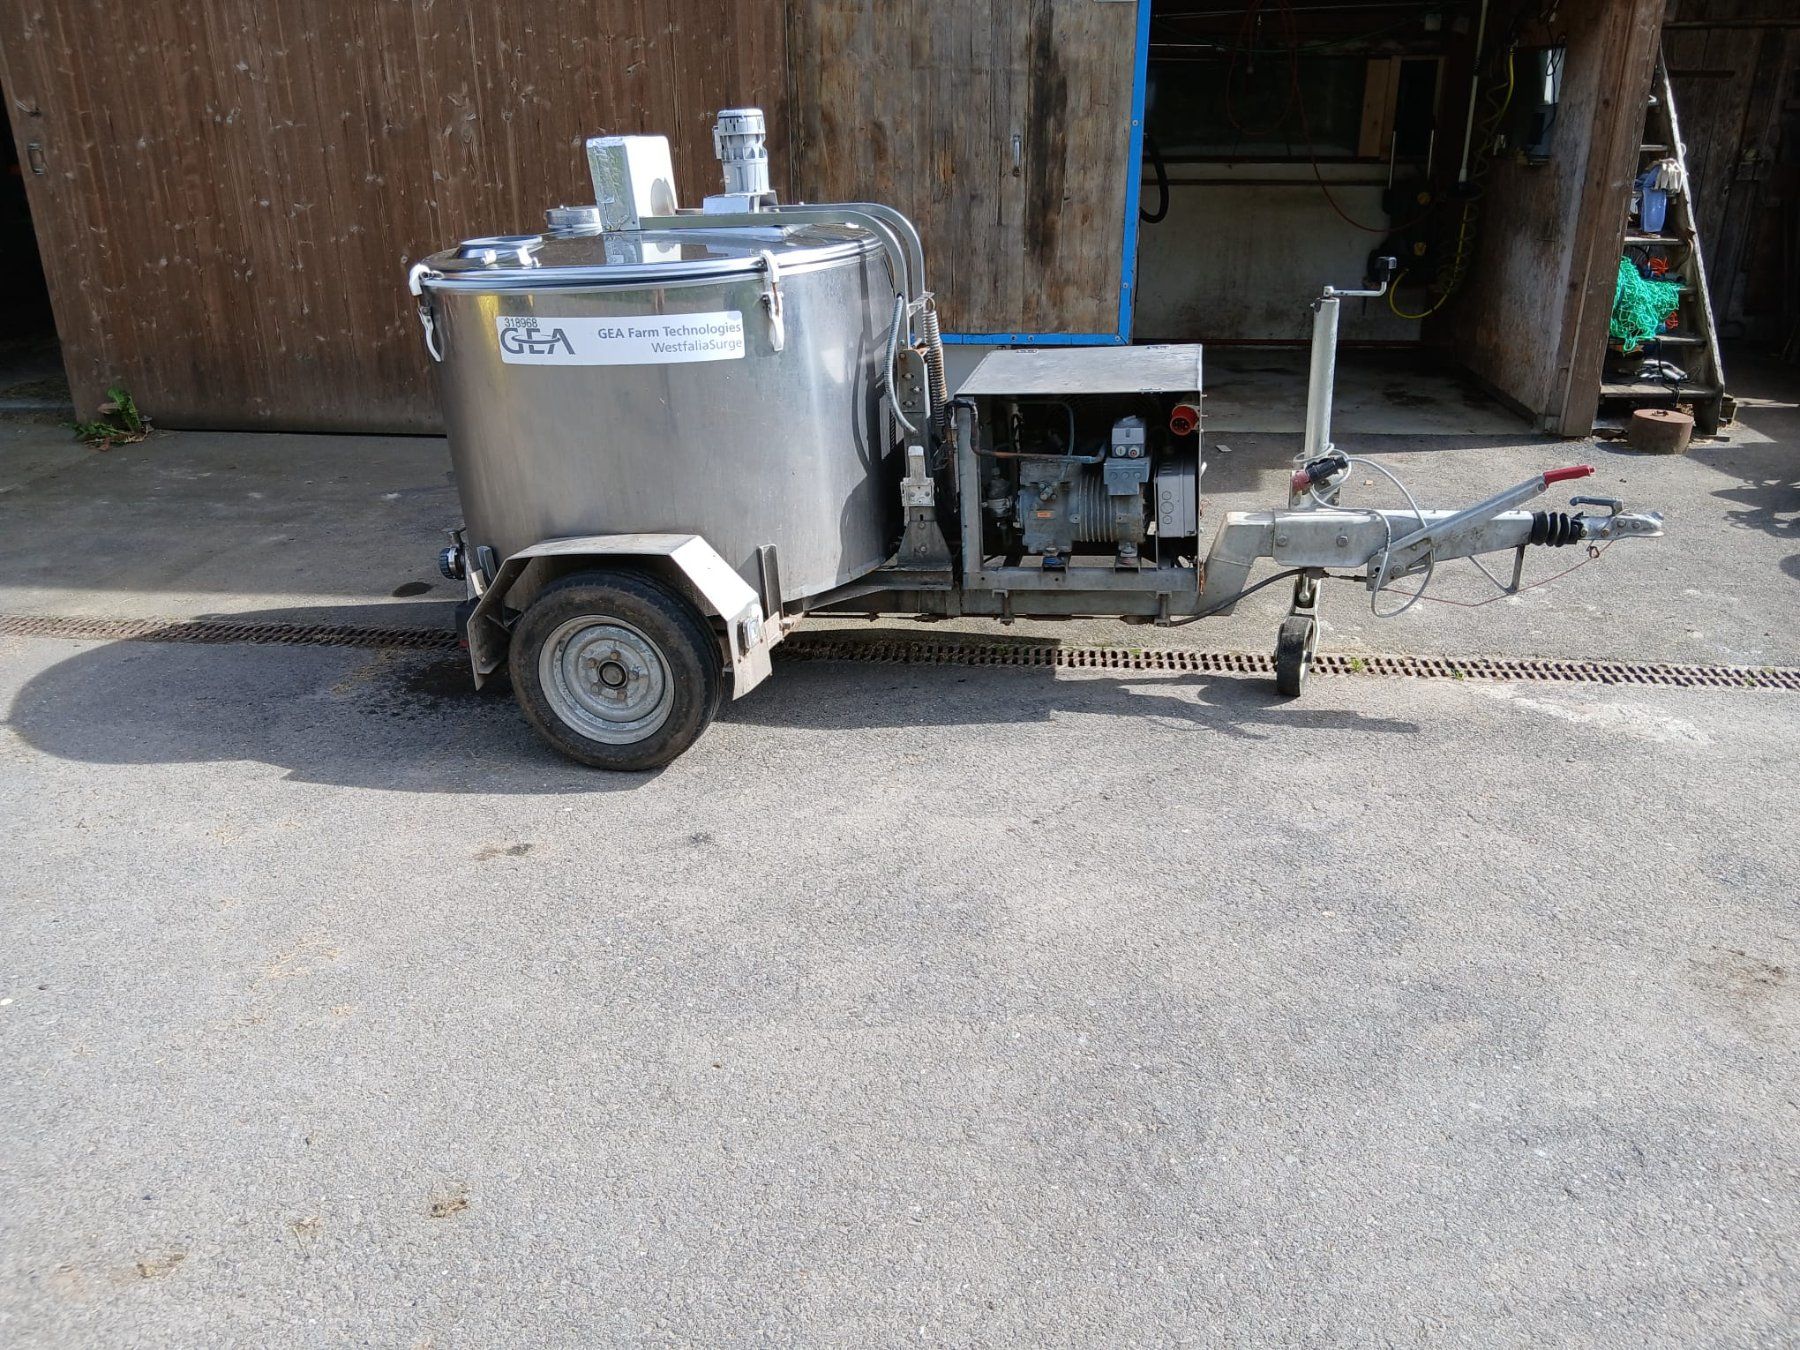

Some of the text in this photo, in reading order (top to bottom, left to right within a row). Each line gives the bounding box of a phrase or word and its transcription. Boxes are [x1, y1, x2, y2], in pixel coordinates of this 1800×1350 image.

[504, 317, 538, 328] 318968
[598, 322, 742, 339] GEA Farm Technologies
[501, 328, 576, 354] GEA
[652, 338, 742, 353] WestfaliaSurge
